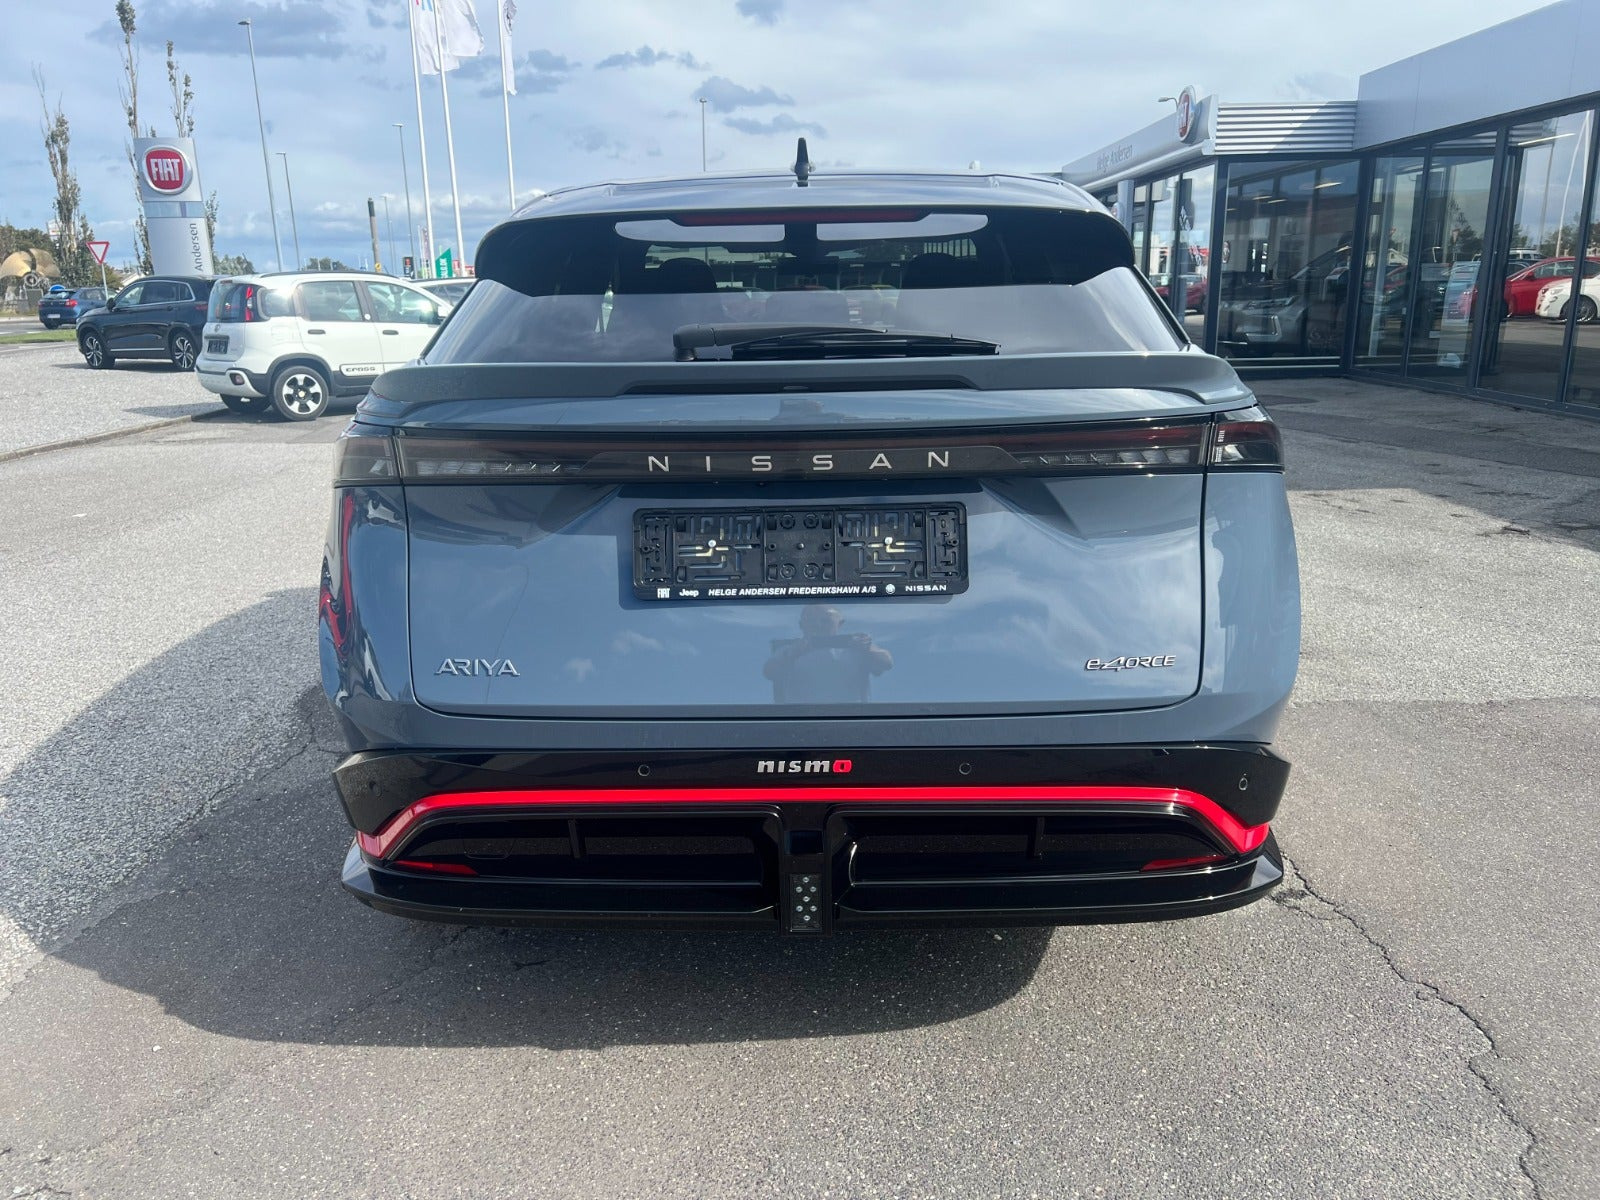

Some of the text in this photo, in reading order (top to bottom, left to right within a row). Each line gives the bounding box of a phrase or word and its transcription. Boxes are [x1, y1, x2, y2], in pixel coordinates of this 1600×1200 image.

[150, 158, 180, 181] FIAT
[189, 222, 204, 272] Andersen
[647, 450, 949, 472] NISSAN
[656, 587, 670, 599] FIAT
[678, 588, 700, 598] Jeep
[707, 585, 877, 596] HELGE ANDERSEN FREDERIKSHAVN A/S
[905, 584, 947, 592] NISSAN
[434, 658, 521, 676] ARIYA
